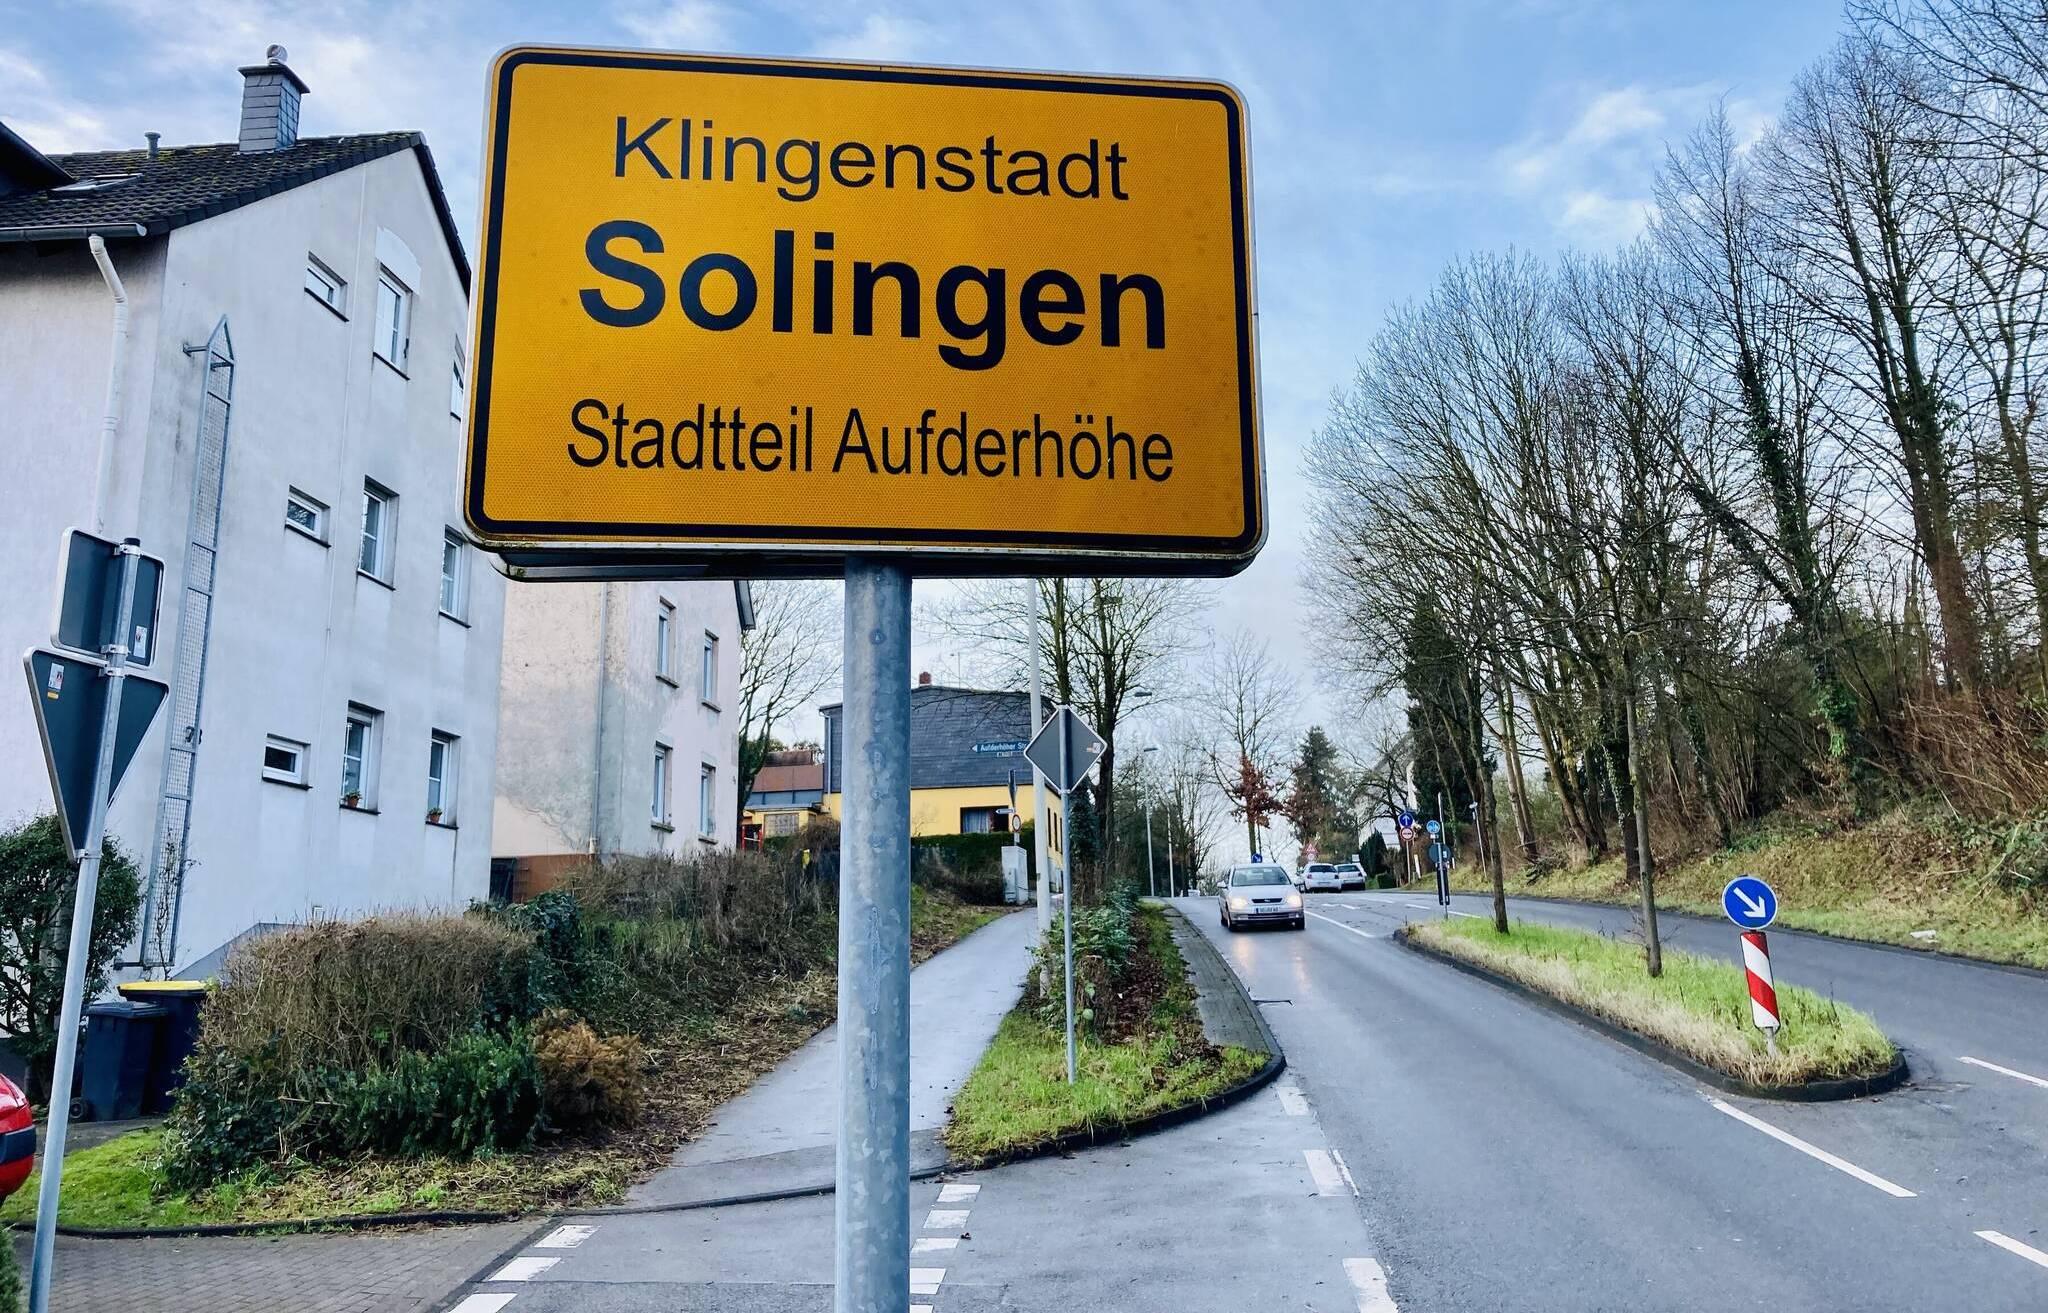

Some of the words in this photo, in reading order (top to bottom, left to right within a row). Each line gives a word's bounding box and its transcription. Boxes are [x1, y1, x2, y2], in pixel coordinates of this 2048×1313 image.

[614, 115, 1129, 202] Klingenstadt
[580, 220, 1165, 371] Solingen
[568, 399, 812, 472] Stadtteil
[832, 408, 1173, 483] Aufderhöhe
